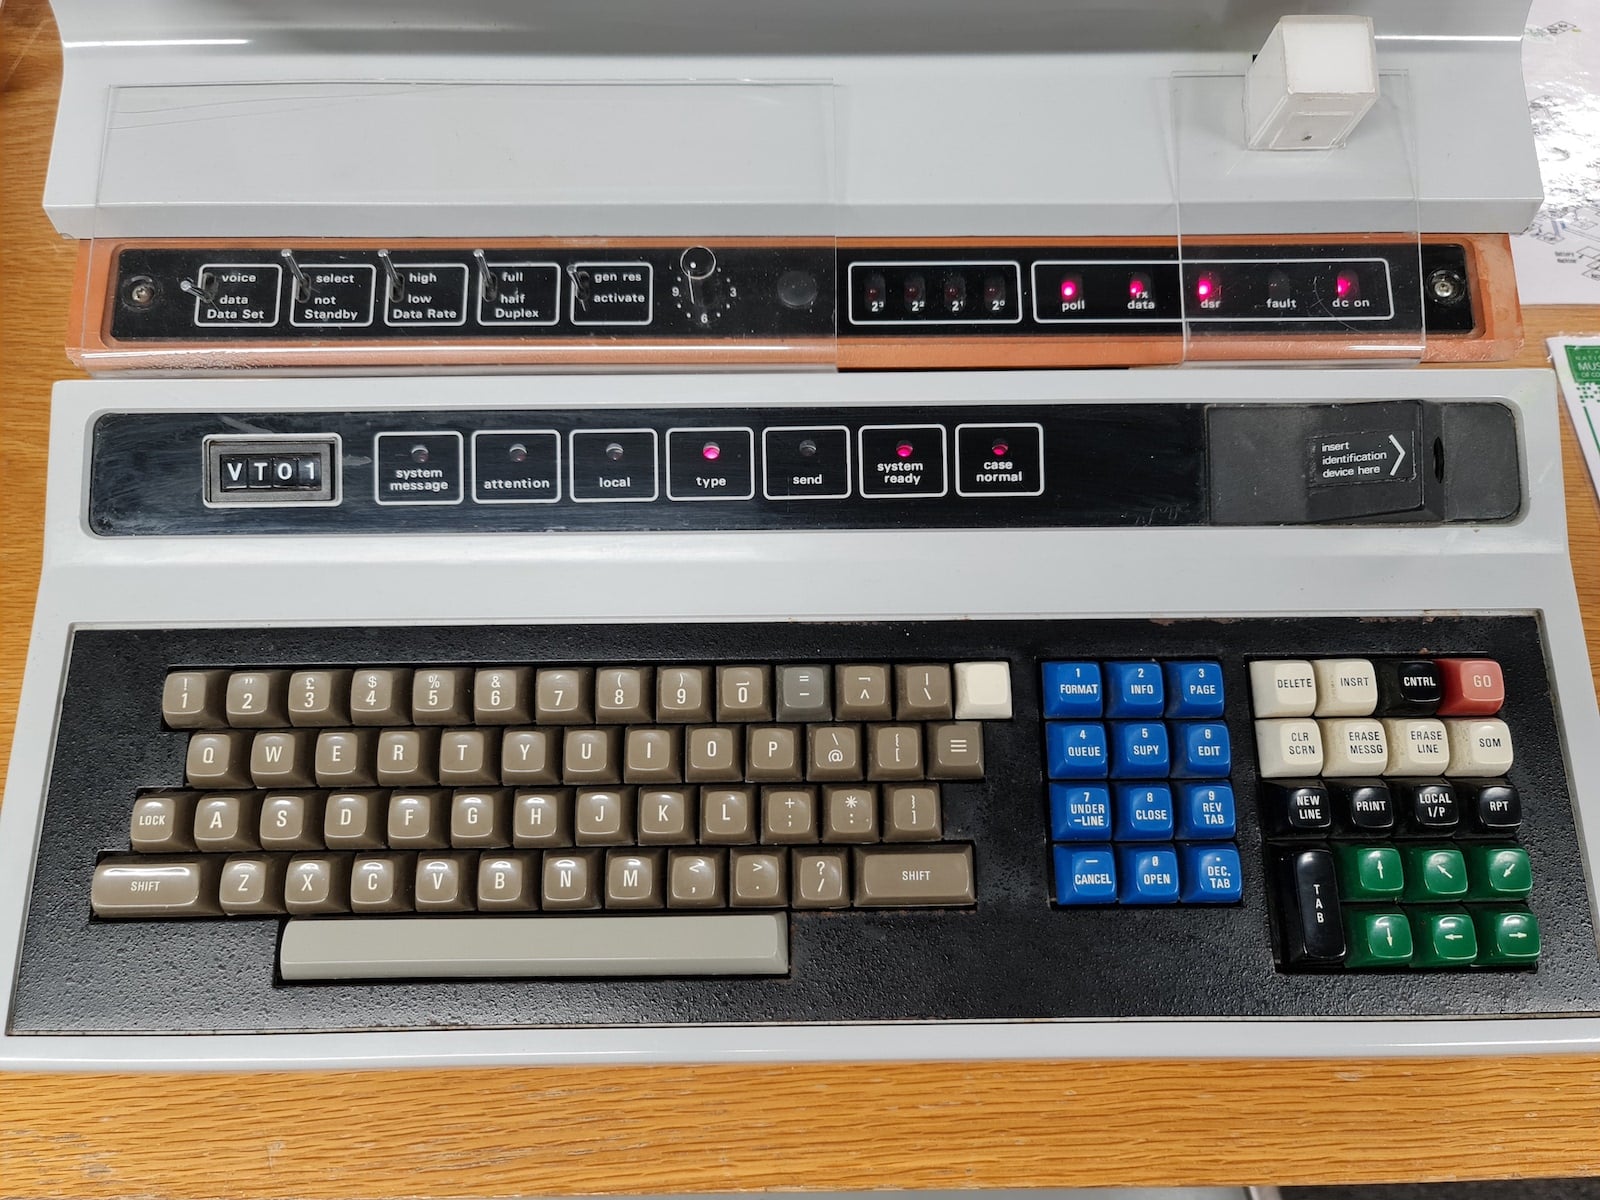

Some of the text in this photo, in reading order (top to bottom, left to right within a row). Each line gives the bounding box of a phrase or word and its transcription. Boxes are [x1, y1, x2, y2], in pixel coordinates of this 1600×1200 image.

[222, 272, 256, 283] voice
[316, 273, 354, 284] select
[409, 271, 437, 285] high
[502, 271, 523, 283] full
[594, 272, 642, 284] gen res
[671, 286, 680, 297] 9
[729, 287, 737, 298] 3
[1136, 291, 1149, 299] rx
[220, 294, 249, 305] data
[314, 294, 336, 305] not
[408, 293, 431, 304] low
[500, 293, 526, 304] half
[593, 292, 645, 304] activate
[1200, 299, 1221, 309] dsr
[1266, 298, 1297, 309] fault
[1332, 297, 1370, 308] dc on
[1061, 300, 1085, 313] poll
[1127, 299, 1155, 310] data
[207, 308, 264, 320] Data Set
[304, 308, 358, 321] Standby
[393, 308, 457, 320] Data Rate
[495, 307, 539, 321] Duplex
[700, 313, 708, 324] 6
[1321, 441, 1350, 453] insert
[1321, 450, 1388, 465] identification
[226, 461, 315, 481] VT01
[877, 461, 924, 474] system
[983, 460, 1013, 471] case
[1322, 464, 1381, 479] device here
[396, 468, 443, 481] system
[792, 474, 823, 486] send
[884, 472, 921, 486] ready
[976, 471, 1023, 483] normal
[390, 480, 449, 492] message
[484, 477, 550, 490] attention
[599, 476, 631, 488] local
[696, 475, 727, 490] type
[1076, 668, 1081, 678] 1
[1137, 668, 1145, 678] 2
[1198, 668, 1205, 678] 3
[1277, 678, 1313, 689] DELETE
[1340, 677, 1369, 687] INSRT
[1403, 676, 1436, 687] CNTRL
[1473, 674, 1492, 688] GO
[738, 687, 748, 703] 0
[1060, 684, 1098, 695] FORMAT
[1130, 684, 1154, 695] INFO
[1190, 684, 1216, 695] PAGE
[181, 693, 188, 709] 1
[242, 693, 253, 709] 2
[304, 692, 315, 708] 3
[365, 690, 377, 706] 4
[428, 690, 439, 706] 5
[491, 690, 501, 706] 6
[554, 690, 564, 706] 7
[614, 689, 624, 705] 8
[676, 688, 686, 704] 9
[1079, 729, 1087, 740] 4
[1141, 728, 1148, 739] 5
[1204, 729, 1212, 740] 6
[1291, 732, 1309, 742] CLR
[1349, 731, 1380, 742] ERASE
[1410, 730, 1442, 741] ERASE
[707, 740, 717, 757] O
[1479, 737, 1502, 748] SOM
[265, 746, 282, 763] W
[332, 745, 342, 762] E
[393, 744, 404, 761] R
[457, 744, 468, 761] T
[520, 744, 530, 761] Y
[581, 743, 592, 760] U
[646, 742, 651, 759] I
[768, 741, 778, 758] P
[1068, 746, 1101, 757] QUEUE
[1133, 745, 1159, 756] SUPY
[1198, 746, 1220, 756] EDIT
[1289, 745, 1316, 755] SCRN
[1350, 744, 1384, 755] MESSG
[1417, 744, 1439, 754] LINE
[202, 747, 214, 764] Q
[828, 750, 843, 763] @
[1083, 792, 1090, 802] 7
[1146, 792, 1153, 803] 8
[1208, 790, 1215, 801] 9
[1297, 796, 1320, 806] NEW
[1419, 793, 1452, 804] LOCAL
[722, 804, 731, 821] L
[1071, 804, 1105, 814] UNDER
[1202, 802, 1222, 813] REV
[1356, 801, 1386, 812] PRINT
[1428, 806, 1446, 818] I/P
[1489, 801, 1509, 812] RPT
[276, 810, 288, 828] S
[340, 808, 352, 826] D
[405, 809, 414, 826] F
[467, 807, 478, 825] G
[530, 807, 542, 825] H
[595, 805, 604, 822] J
[658, 804, 669, 822] K
[1135, 809, 1168, 820] CLOSE
[1299, 808, 1322, 820] LINE
[139, 815, 166, 826] LOCK
[210, 811, 223, 829] A
[1204, 814, 1225, 825] TAB
[1152, 856, 1159, 867] 0
[902, 870, 931, 881] SHIFT
[1207, 866, 1231, 877] DEC.
[238, 874, 249, 892] Z
[301, 874, 313, 892] X
[368, 873, 378, 891] C
[432, 872, 444, 890] V
[495, 872, 505, 890] B
[560, 870, 572, 888] N
[623, 869, 638, 887] M
[1075, 874, 1112, 885] CANCEL
[1143, 874, 1171, 885] OPEN
[1209, 878, 1231, 889] TAB
[130, 881, 161, 893] SHIFT
